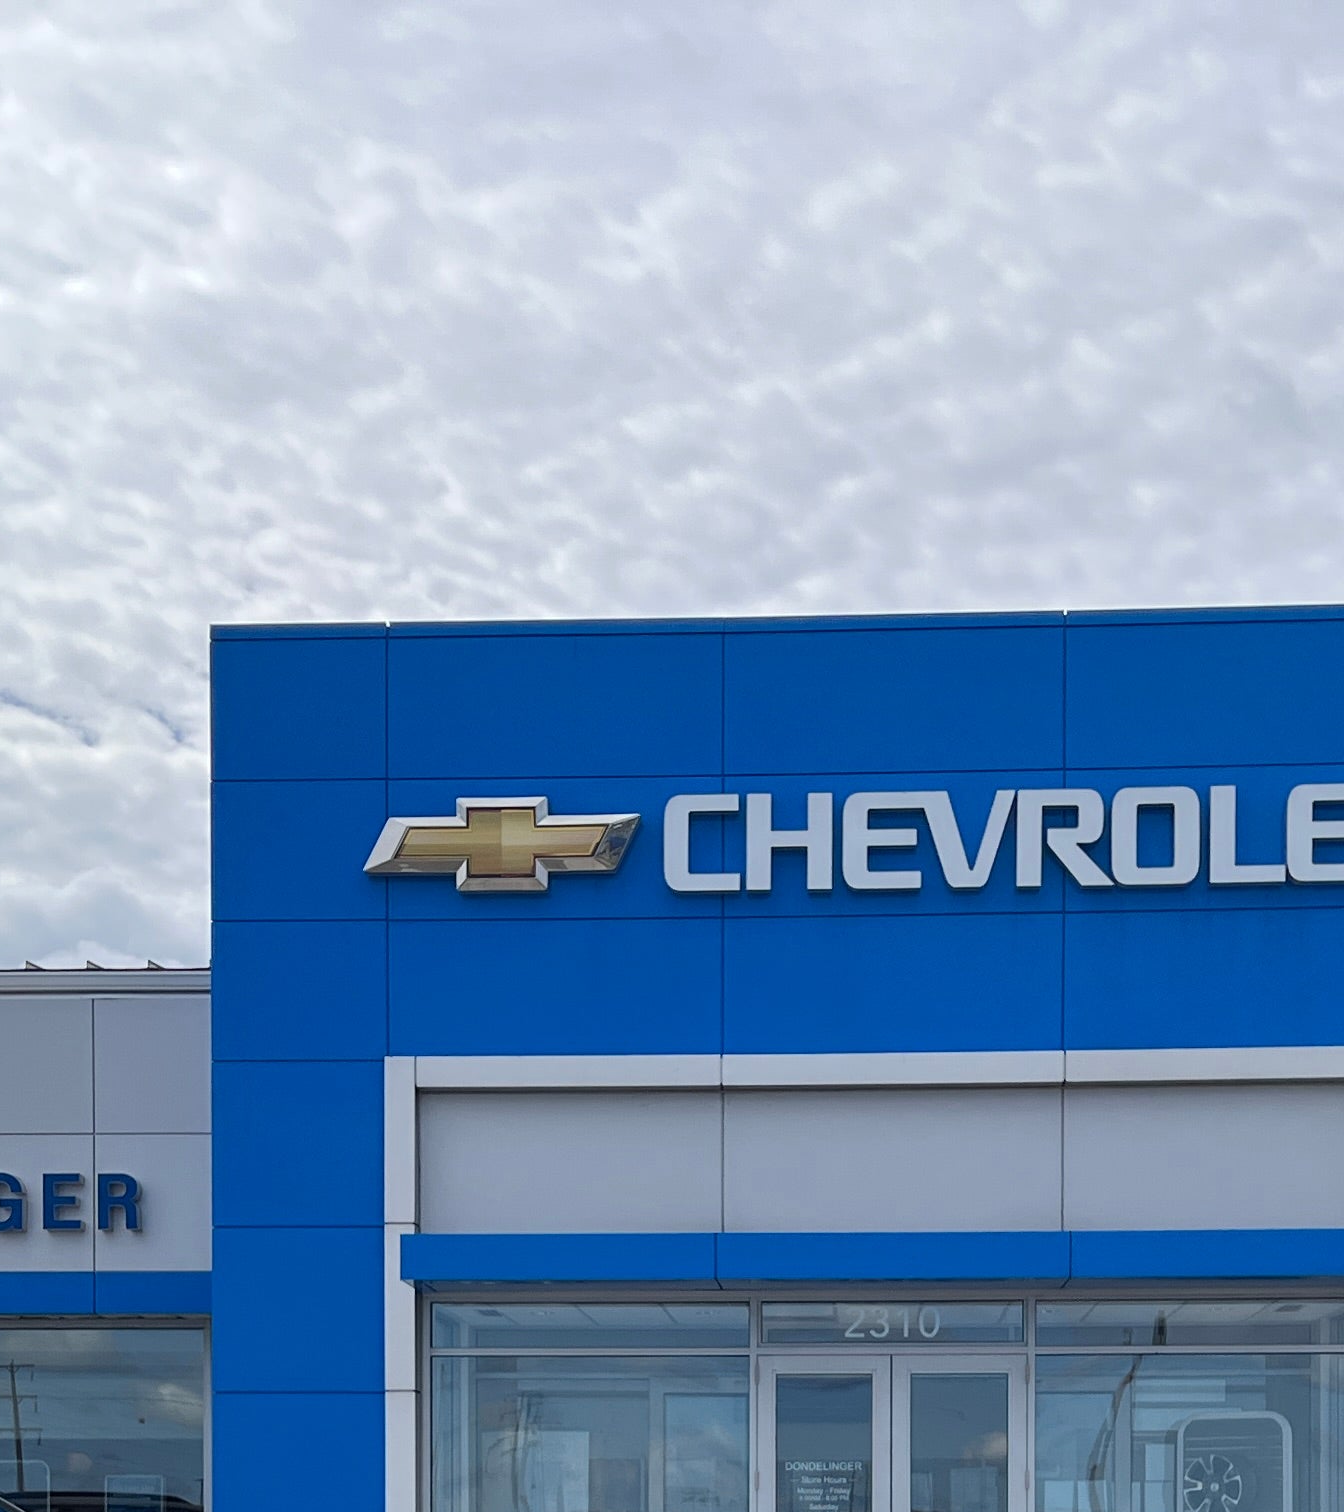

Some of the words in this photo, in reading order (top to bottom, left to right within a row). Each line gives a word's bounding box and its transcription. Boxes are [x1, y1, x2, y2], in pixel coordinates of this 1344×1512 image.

[843, 1305, 942, 1339] 2310
[784, 1461, 863, 1471] DONDELINGER
[823, 1475, 847, 1484] Hours
